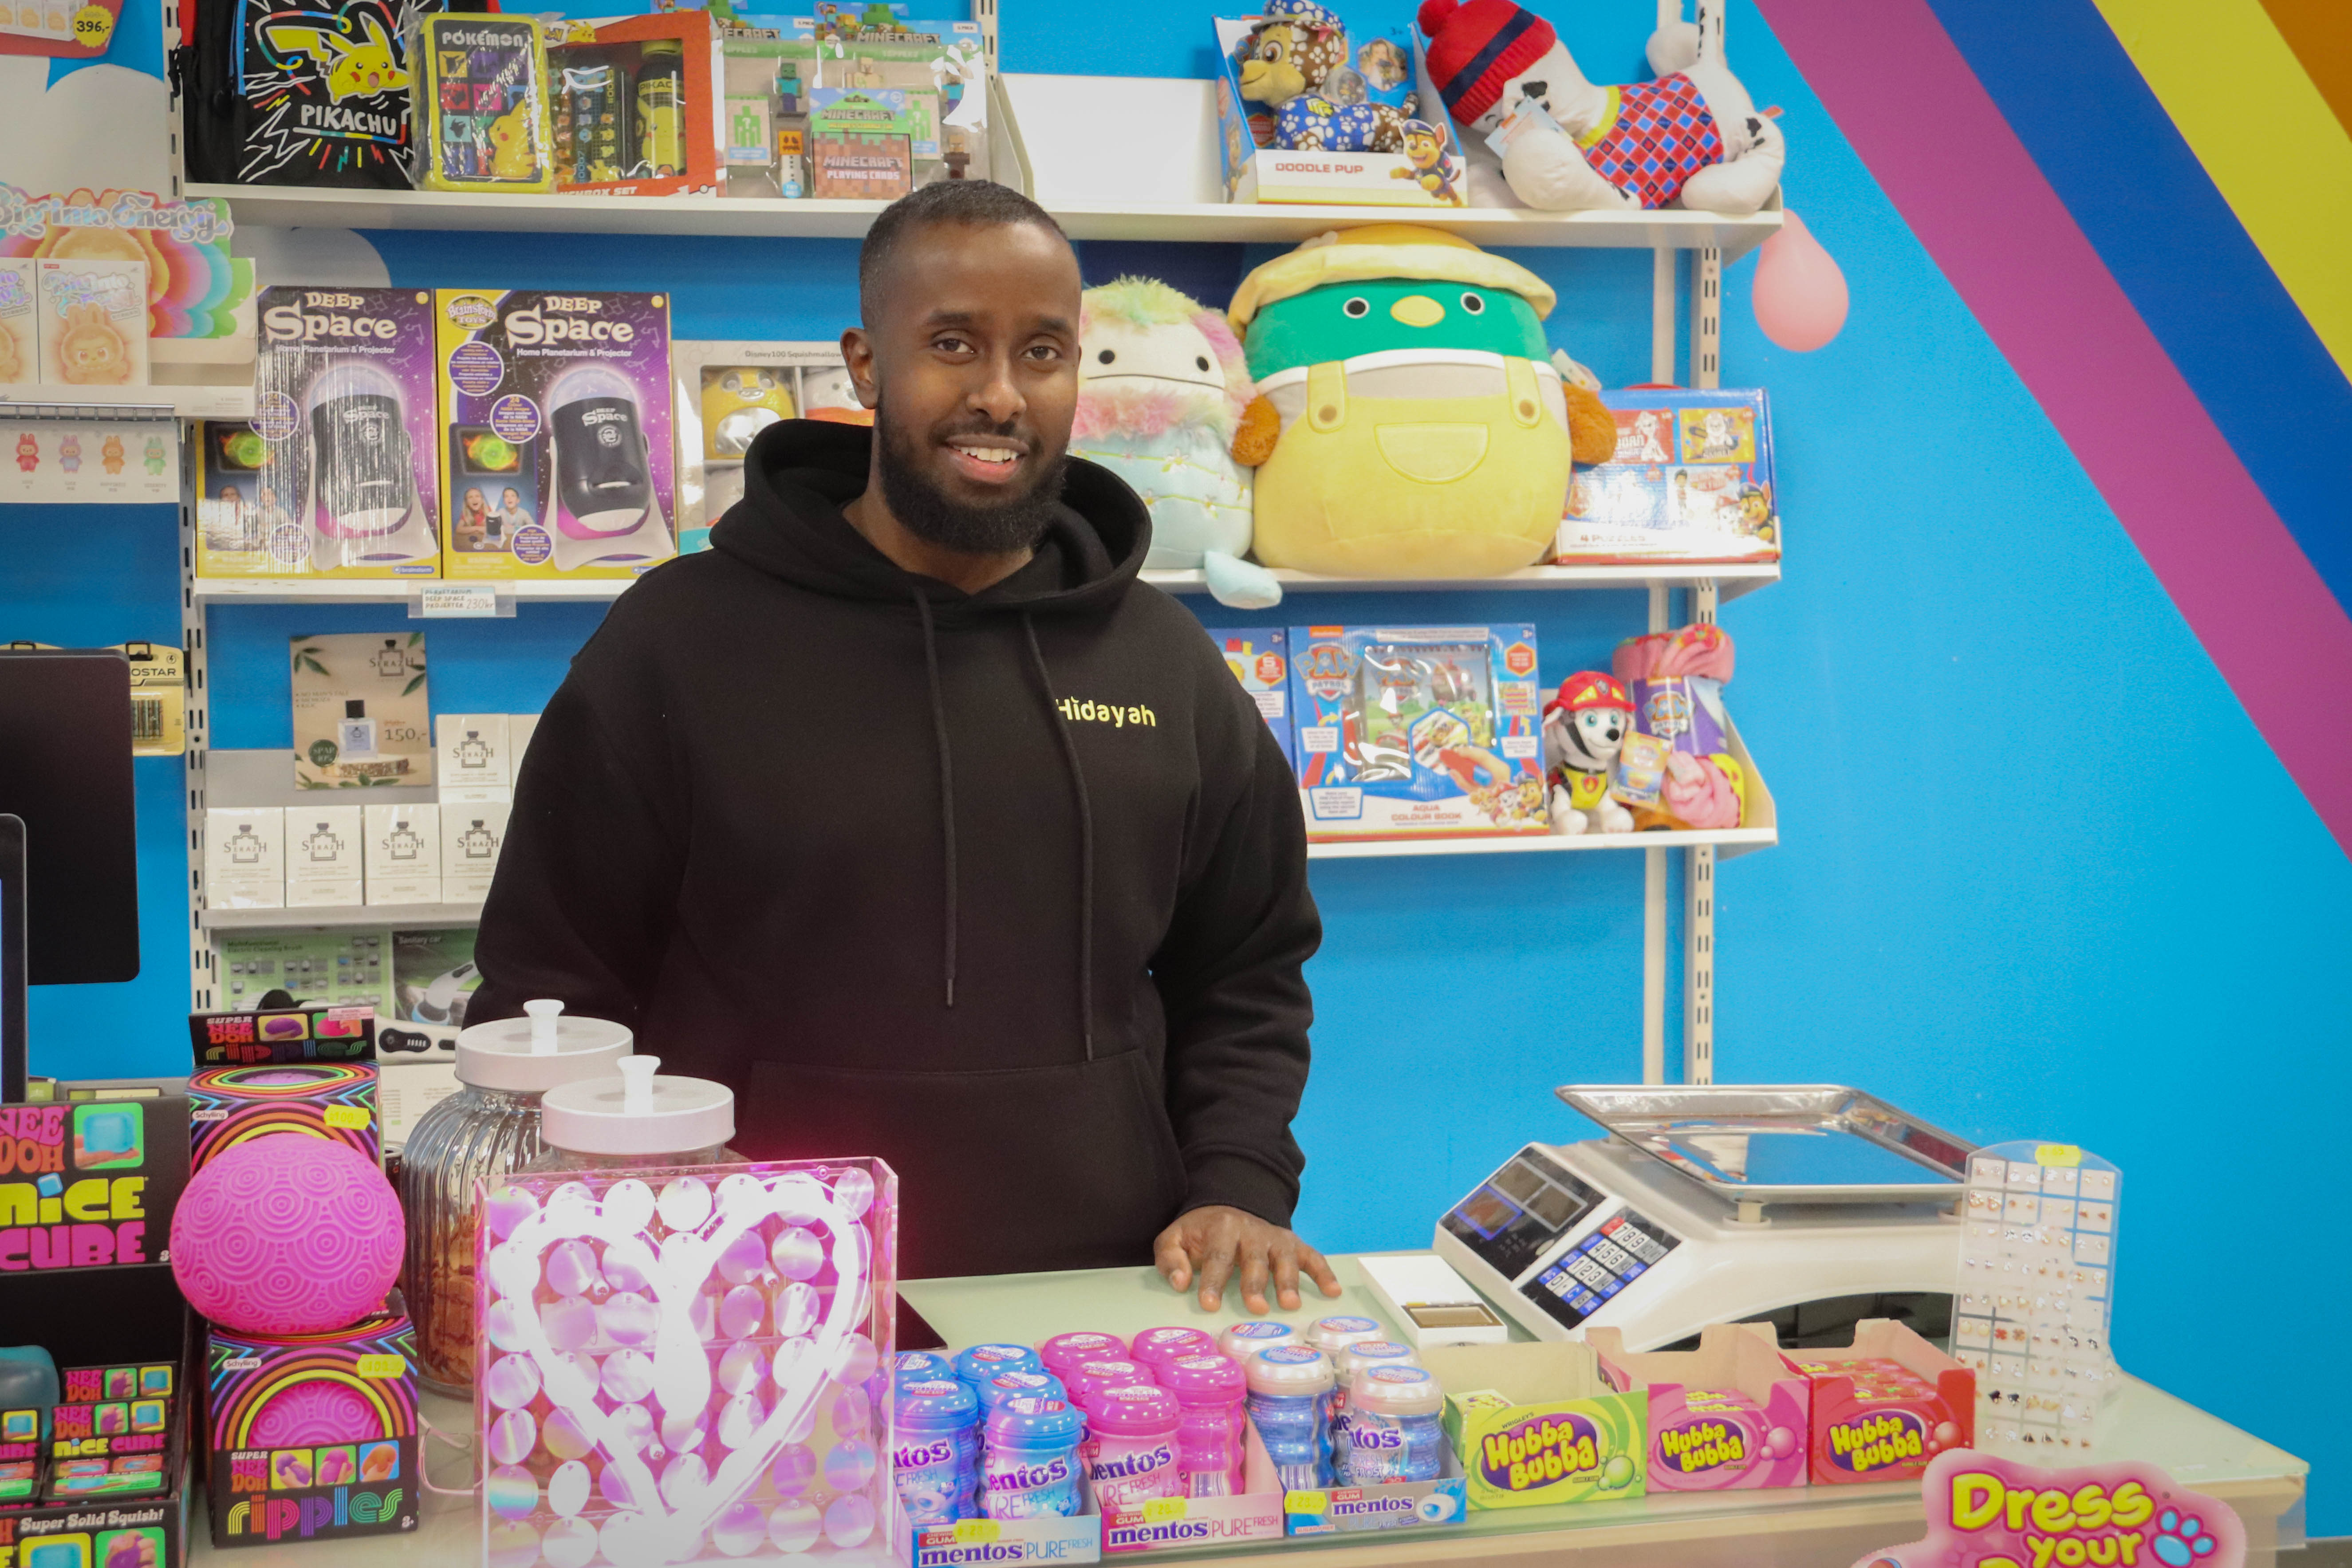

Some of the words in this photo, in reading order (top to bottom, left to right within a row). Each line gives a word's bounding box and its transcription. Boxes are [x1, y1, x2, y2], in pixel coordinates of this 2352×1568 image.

[76, 20, 110, 33] 396,-
[723, 28, 781, 39] ECRAFT
[857, 32, 941, 44] MINECRAFT
[301, 104, 397, 135] PIKACHU
[821, 110, 895, 121] MINECRAFT
[823, 156, 903, 169] MINECRAFT
[1276, 162, 1331, 173] DOODLE
[1335, 164, 1363, 174] PUP
[827, 170, 868, 180] PLAYING
[869, 171, 900, 180] CARDS
[613, 186, 638, 195] SET
[305, 291, 365, 310] DEEP
[544, 295, 602, 312] DEEP
[264, 299, 398, 345] Space
[504, 304, 634, 350] Space
[303, 345, 349, 354] Planetarium
[359, 345, 396, 355] Projector
[516, 348, 540, 357] Home
[541, 348, 587, 357] Planetarium
[589, 349, 596, 357] &
[596, 349, 632, 358] Projector
[745, 350, 786, 359] Disney100
[788, 351, 842, 359] Squishmallow
[582, 411, 628, 427] Space
[1293, 651, 1363, 680] PAW
[1055, 695, 1156, 728] Hidayah
[385, 728, 427, 742] 150,-
[453, 748, 494, 758] SERAZH
[223, 842, 267, 853] SERAZH
[302, 839, 345, 851] SERAZH
[382, 838, 425, 849] SERAZH
[457, 837, 500, 848] SERAZH
[207, 1023, 253, 1036] NEE
[210, 1033, 254, 1044] DOH
[1616, 1226, 1627, 1238] 7
[1623, 1232, 1636, 1242] 8
[1631, 1238, 1645, 1248] 9
[0, 1221, 146, 1272] CUBE
[1596, 1243, 1607, 1253] 4
[1601, 1248, 1615, 1258] 5
[1610, 1255, 1623, 1265] 6
[1572, 1260, 1584, 1271] 1
[1580, 1266, 1593, 1276] 2
[1588, 1272, 1601, 1282] 3
[1551, 1276, 1564, 1286] 0
[227, 1359, 259, 1368] Schylling
[65, 1369, 102, 1387] NEE
[67, 1383, 102, 1403] DOH
[53, 1404, 93, 1424] NEE
[1502, 1411, 1534, 1429] WRIGLEY'S
[55, 1420, 92, 1440] DOH
[1831, 1416, 1903, 1455] Hubba
[111, 1434, 166, 1452] CUBE
[1484, 1420, 1574, 1471] Hubba
[1660, 1423, 1726, 1457] Hubba
[231, 1451, 268, 1460] SUPER
[894, 1438, 953, 1469] ntos
[1680, 1436, 1744, 1473] Bubba
[1851, 1430, 1923, 1472] Bubba
[231, 1458, 268, 1475] NEE
[1510, 1435, 1596, 1490] Bubba
[906, 1469, 938, 1485] FRESH
[987, 1456, 1069, 1490] entos
[1129, 1473, 1161, 1490] FRESH
[232, 1473, 268, 1493] DOH
[1023, 1488, 1056, 1504] FRESH
[1951, 1472, 2154, 1533] Dress
[228, 1486, 403, 1540] ripples
[1333, 1496, 1414, 1516] mentos
[20, 1517, 65, 1533] Super
[67, 1512, 105, 1528] Solid
[107, 1508, 164, 1526] Squish!
[1115, 1516, 1145, 1525] GUM
[1110, 1521, 1209, 1544] mentos
[1212, 1517, 1253, 1537] PURE
[1253, 1516, 1278, 1526] FRESH
[926, 1536, 957, 1545] GUM
[920, 1542, 1023, 1566] mentos
[1026, 1540, 1068, 1559] PURE
[1068, 1537, 1093, 1548] FRESH
[2026, 1532, 2143, 1568] your
